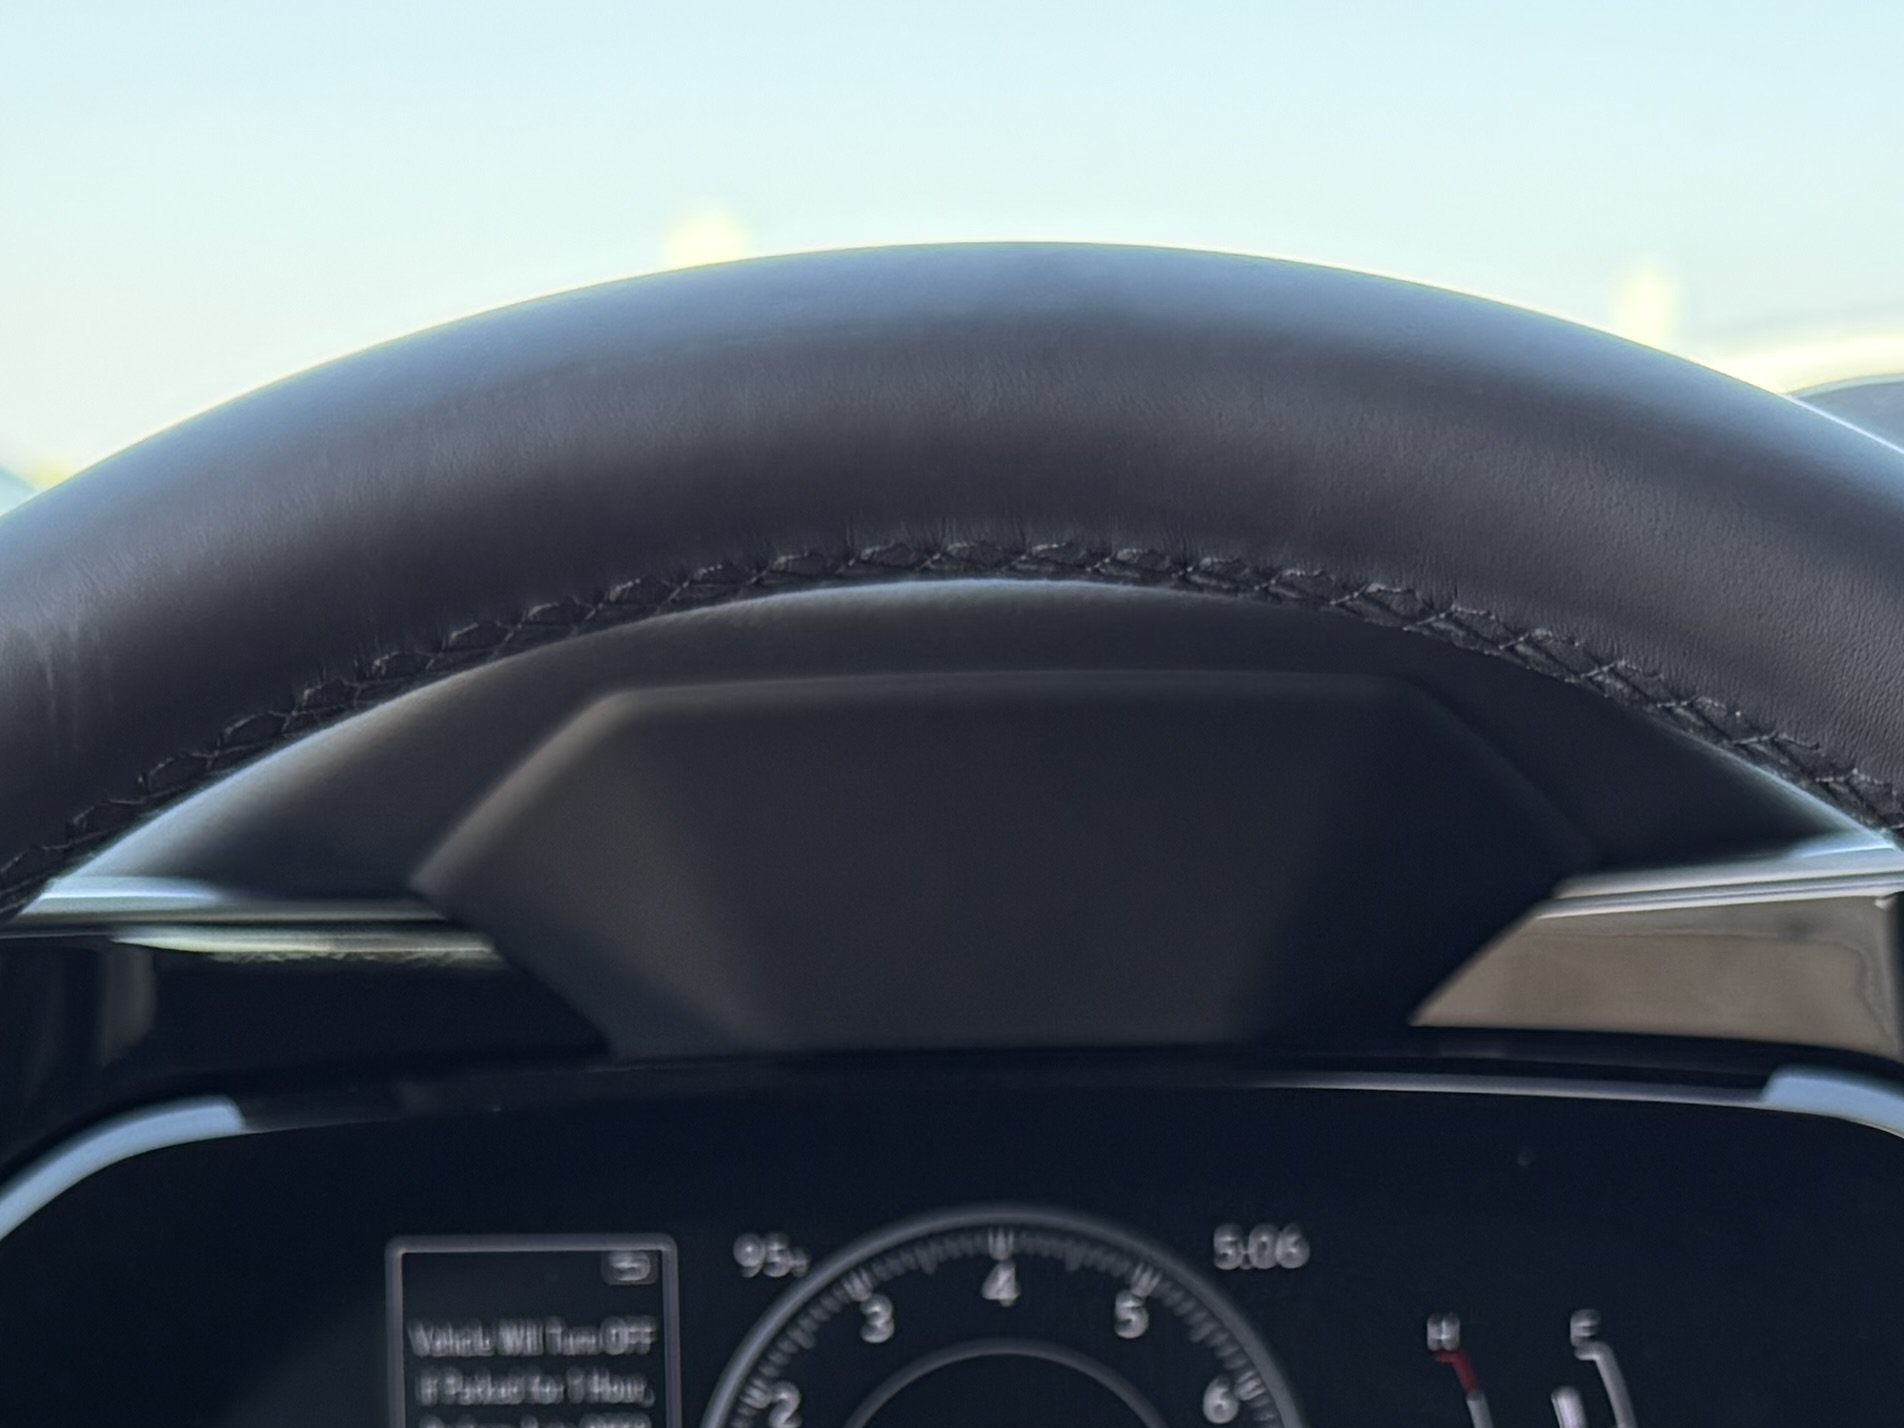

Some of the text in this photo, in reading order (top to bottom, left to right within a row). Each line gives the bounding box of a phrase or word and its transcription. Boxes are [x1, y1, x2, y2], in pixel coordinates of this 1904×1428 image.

[981, 1261, 1020, 1306] 4
[601, 1315, 656, 1355] OFF
[861, 1295, 895, 1343] 3
[1115, 1289, 1148, 1339] 5
[1203, 1376, 1238, 1423] 6
